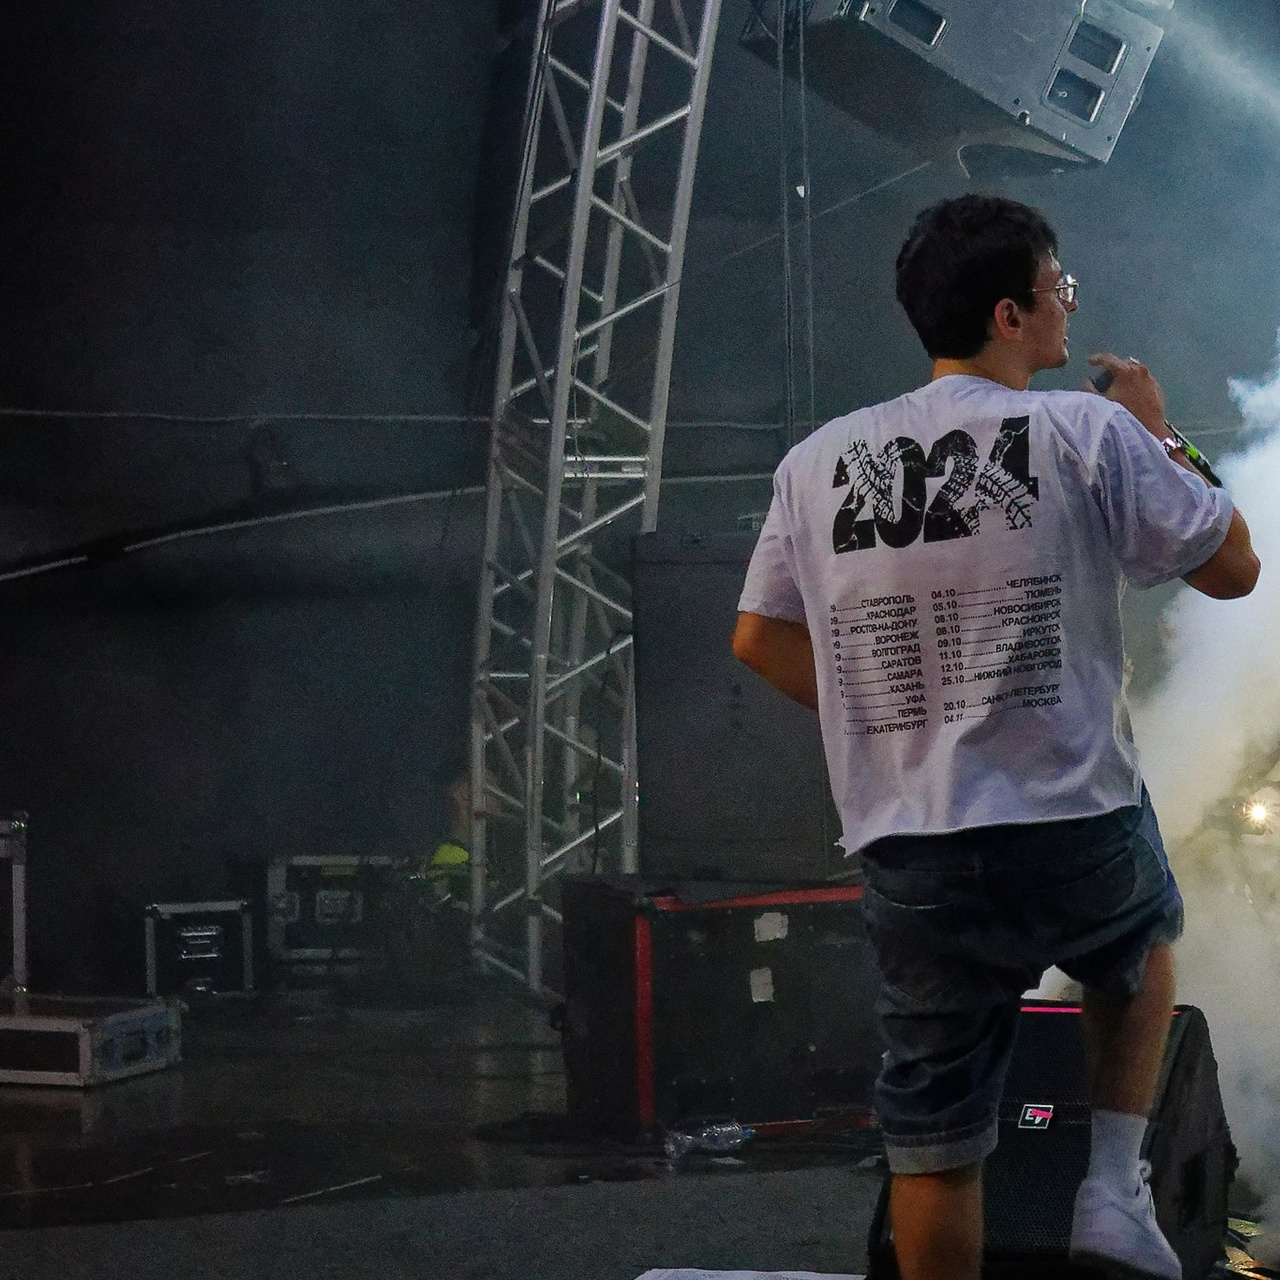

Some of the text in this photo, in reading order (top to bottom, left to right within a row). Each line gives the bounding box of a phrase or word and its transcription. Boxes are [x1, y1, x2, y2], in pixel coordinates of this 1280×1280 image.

[832, 415, 1039, 555] 2024
[931, 574, 1062, 600] 04.10 ЧЕЛЯБИНСК
[861, 594, 915, 609] СТАВРОПОЛЬ
[933, 586, 1062, 612] 05.10 ТЮМЕНЬ
[993, 597, 1062, 616] НОВОСИБИРСК
[866, 606, 917, 620] КРАСНОДАР
[1001, 609, 1061, 627] КРАСНОЯРСК
[850, 618, 917, 635] РОСТОВ-НА-ДОНУ
[875, 630, 919, 645] ВОРОНЕЖ
[937, 623, 1061, 648] 09.10 ИРКУТСК
[871, 643, 921, 658] ВОЛГОГРАД
[939, 635, 1062, 661] 11.10 ВЛАДИВОСТОК
[881, 656, 922, 670] САРАТОВ
[941, 648, 1062, 673] 12.10 ХАБАРОВСК
[887, 668, 924, 682] САМАРА
[941, 674, 965, 686] 25.10
[890, 681, 925, 694] КАЗАНЬ
[905, 694, 927, 705] УФА
[943, 700, 966, 711] 20.10
[1022, 695, 1062, 708] МОСКВА
[897, 706, 927, 719] ПЕРМЬ
[866, 719, 928, 735] ЕКАТЕРИНБУРГ
